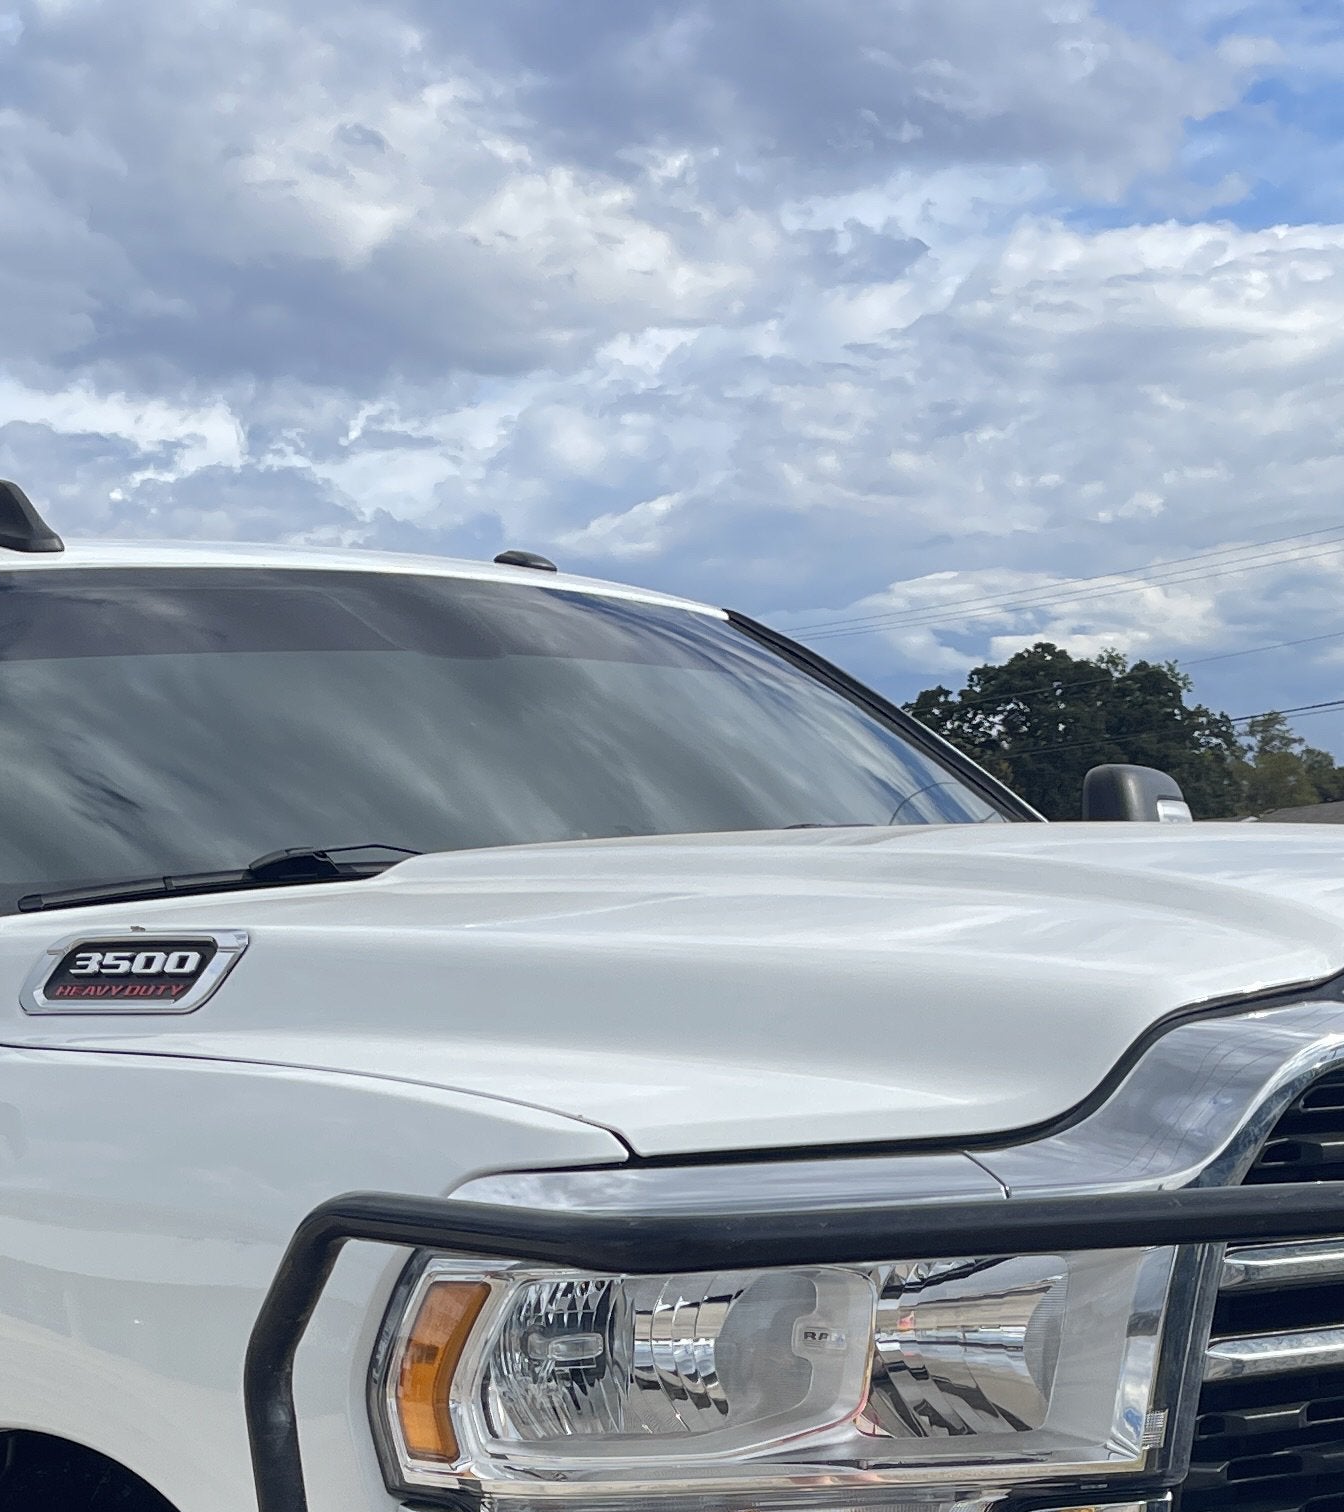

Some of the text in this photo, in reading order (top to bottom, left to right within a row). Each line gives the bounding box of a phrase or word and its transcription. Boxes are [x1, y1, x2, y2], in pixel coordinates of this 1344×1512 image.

[69, 951, 202, 977] 3500
[55, 985, 185, 996] HEAVY DUTY
